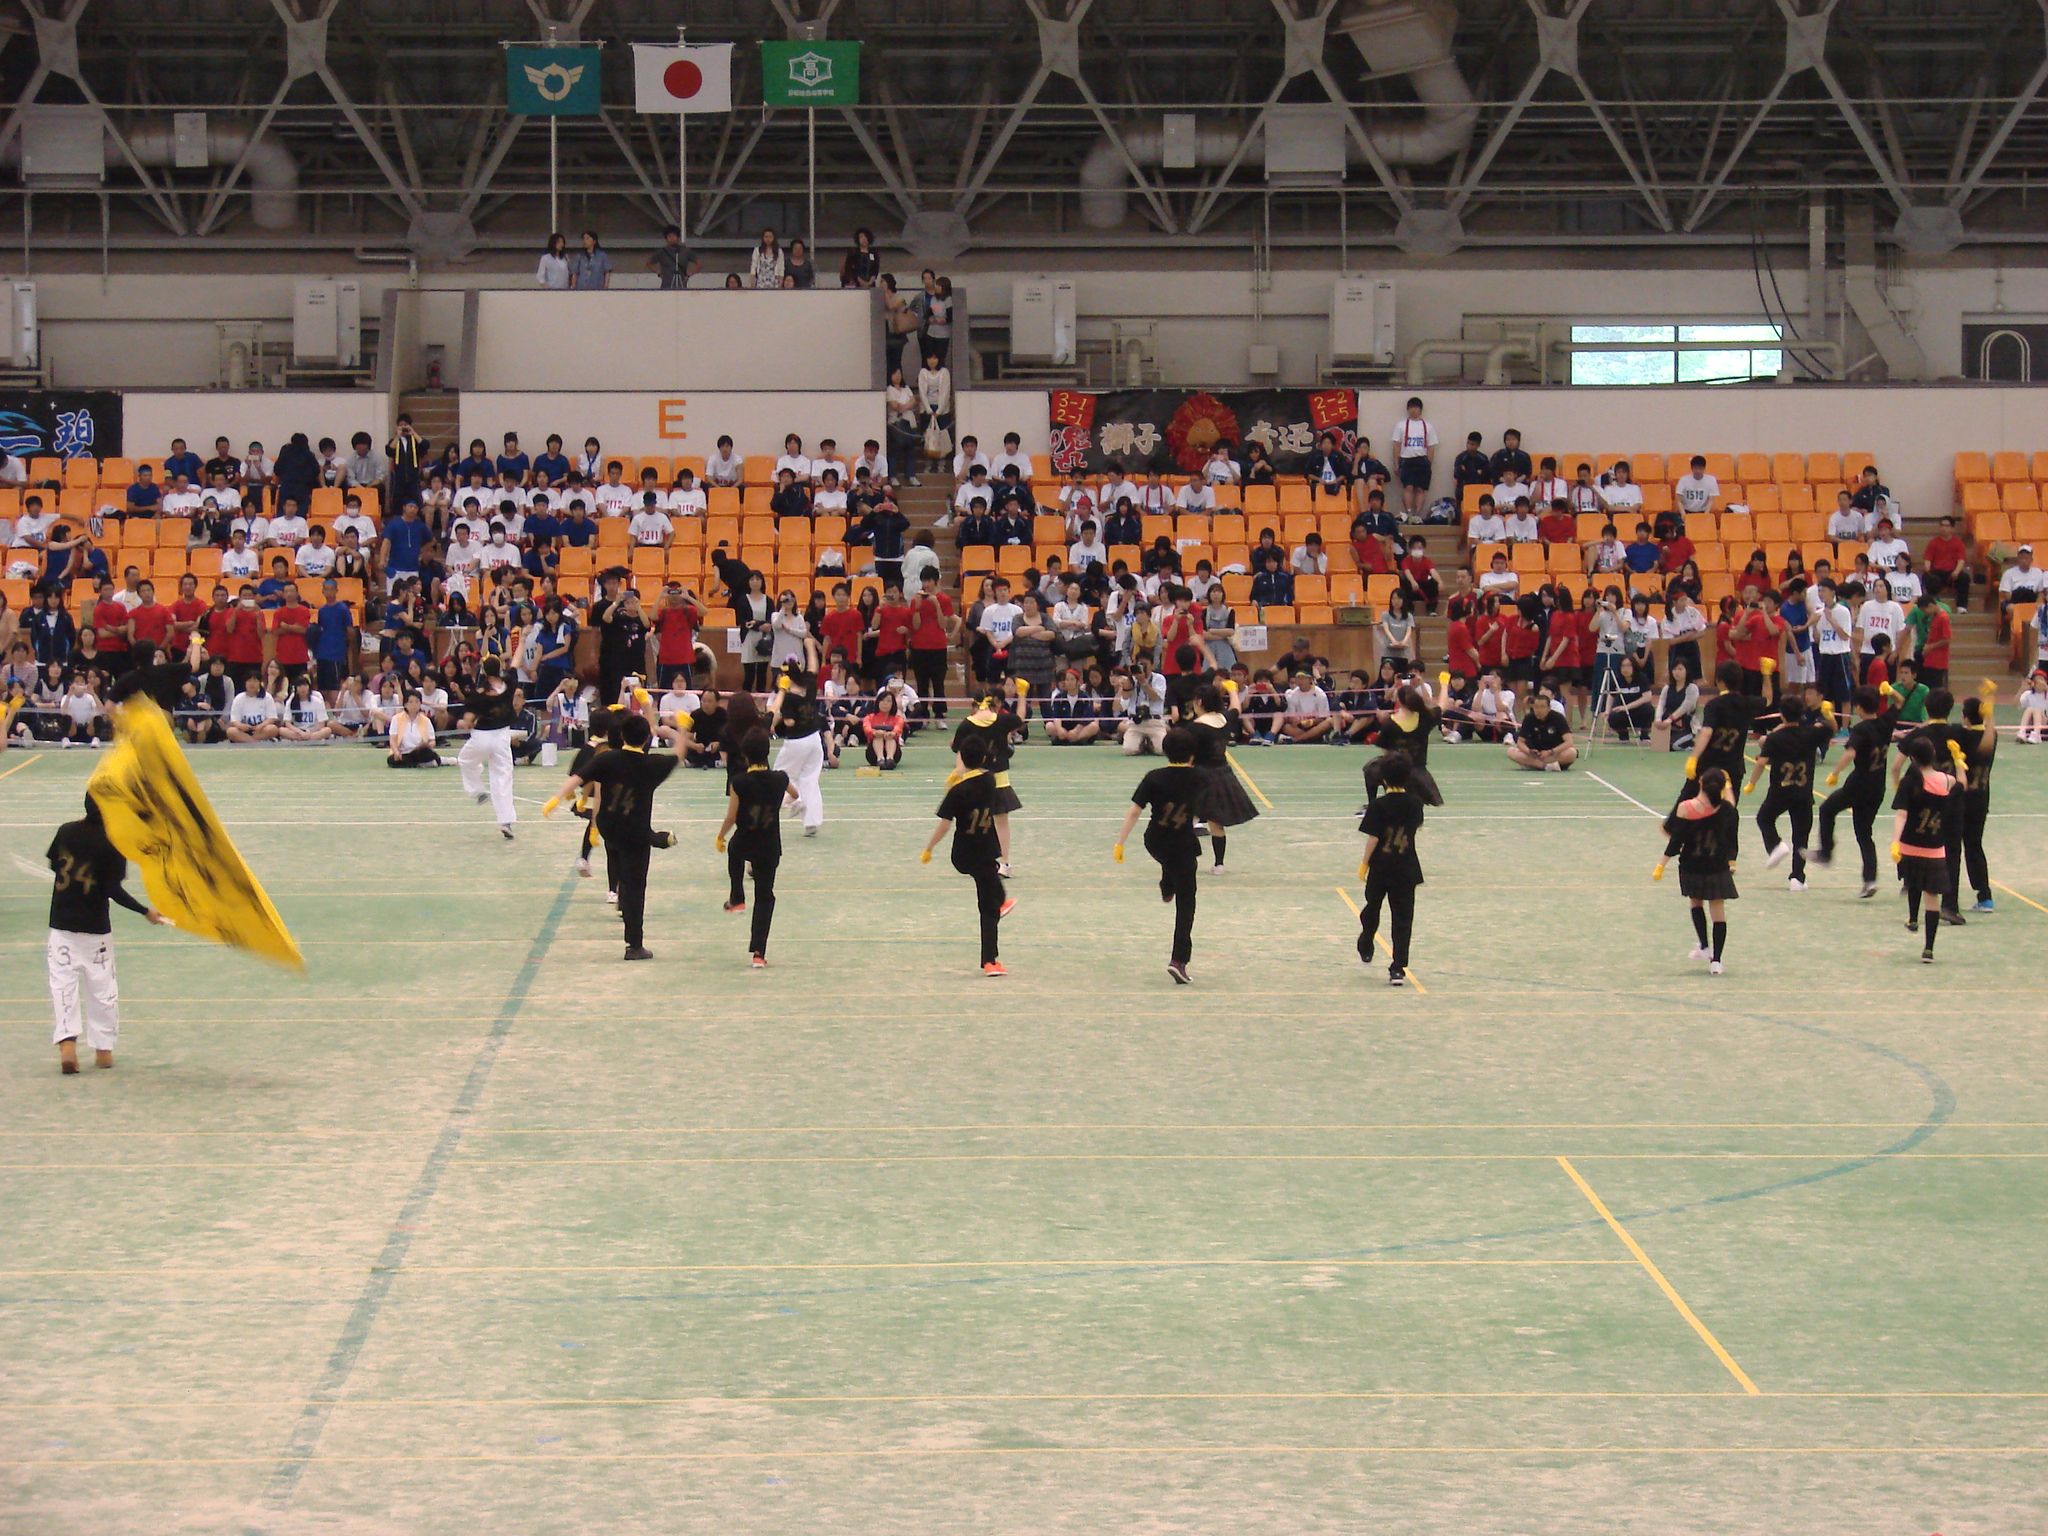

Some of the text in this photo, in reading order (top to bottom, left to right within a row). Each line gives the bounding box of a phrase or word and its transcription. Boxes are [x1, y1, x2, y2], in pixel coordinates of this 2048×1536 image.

[803, 58, 818, 78] 高
[1059, 392, 1088, 411] 3-1
[1314, 391, 1348, 409] 2-2
[659, 400, 686, 439] E
[1056, 409, 1083, 425] 2-1
[1321, 406, 1349, 424] 1-5
[1686, 490, 1704, 500] 1510
[1870, 616, 1890, 629] 3212
[1780, 761, 1807, 787] 23
[966, 807, 992, 834] 14
[1158, 801, 1188, 829] 14
[1915, 808, 1942, 834] 14
[1382, 826, 1409, 854] 14
[55, 850, 97, 895] 34
